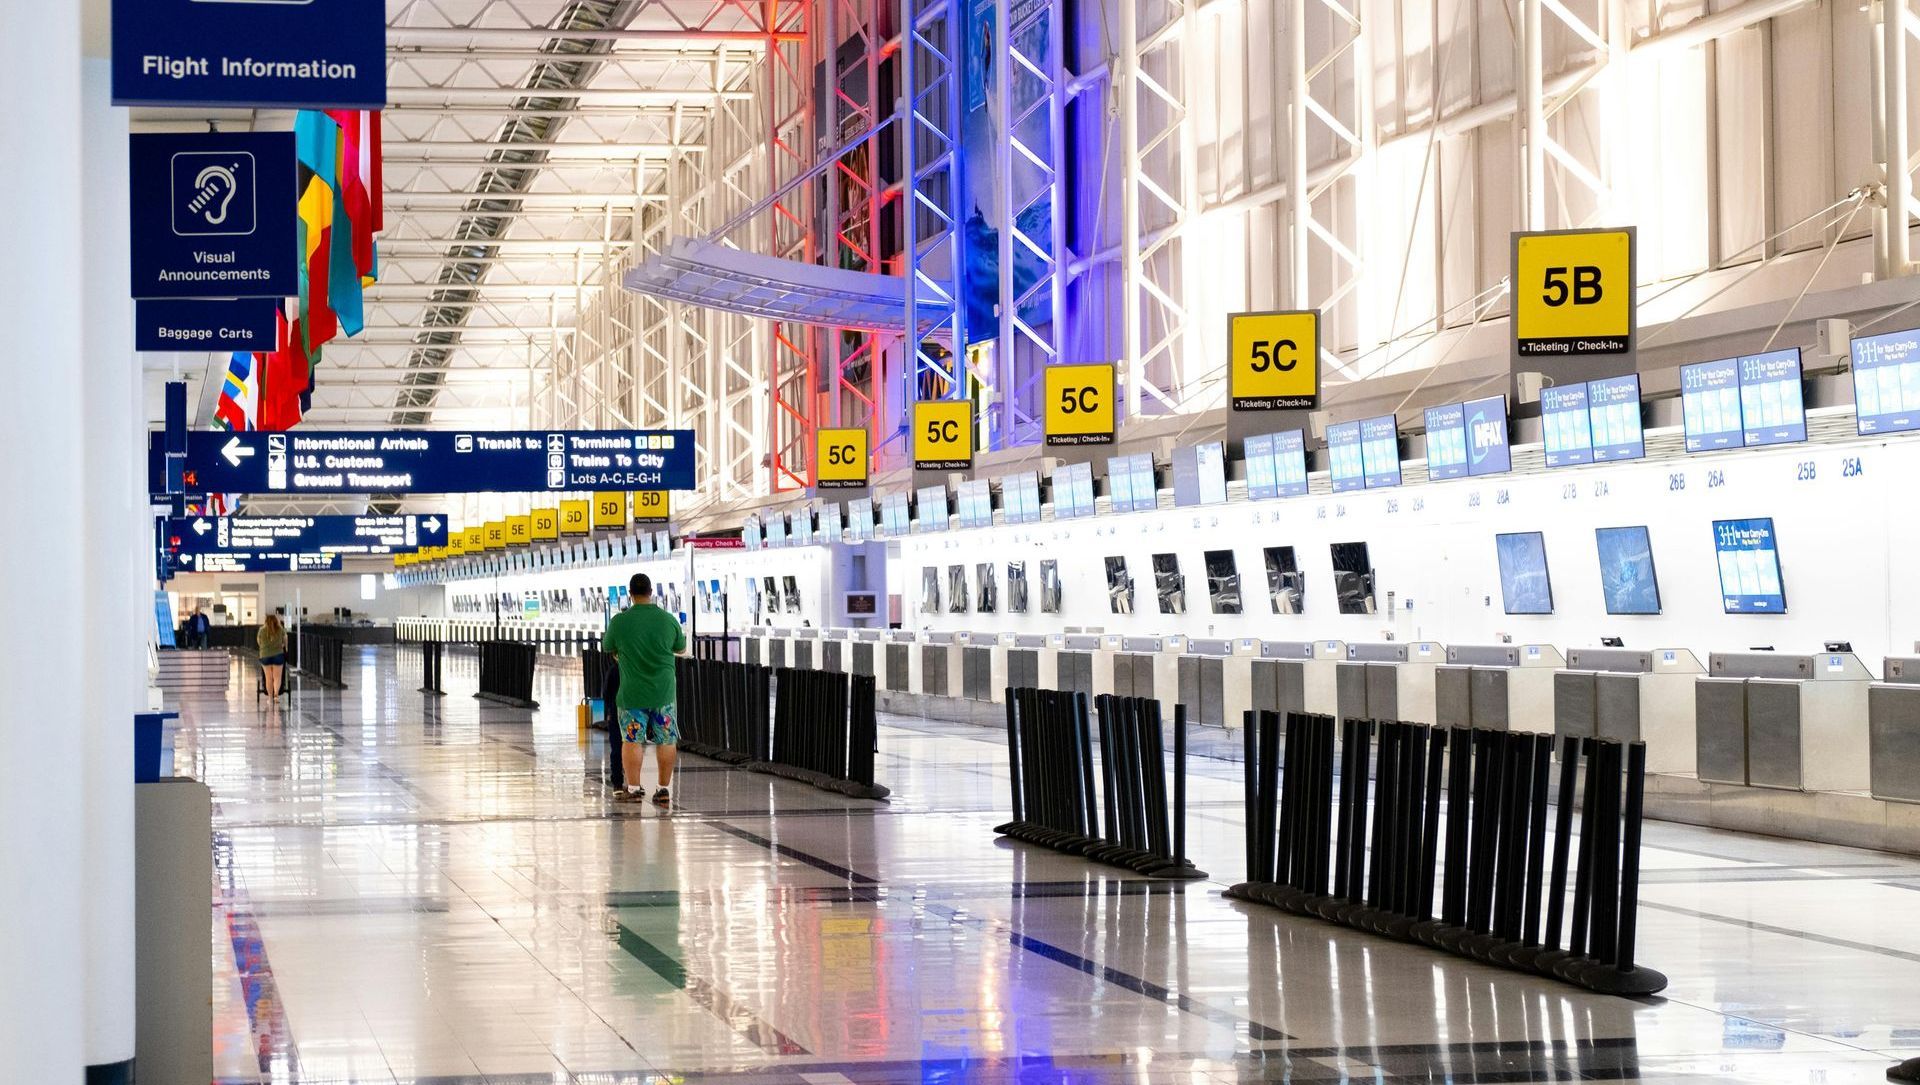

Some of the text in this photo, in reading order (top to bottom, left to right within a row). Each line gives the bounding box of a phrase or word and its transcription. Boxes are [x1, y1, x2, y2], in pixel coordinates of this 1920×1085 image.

[142, 55, 356, 80] Flight Information
[193, 250, 235, 264] Visual
[159, 267, 270, 281] Announcements
[1542, 266, 1603, 307] 5B
[158, 327, 253, 341] Baggage Carts
[1527, 342, 1569, 353] Ticketing
[1577, 340, 1618, 351] Check-In
[1857, 341, 1878, 364] 3-1-1
[1250, 339, 1297, 372] 5C
[1743, 359, 1761, 380] 3-1-1
[1685, 367, 1702, 388] 3-1-1
[1061, 386, 1098, 414] 5C
[1544, 390, 1559, 410] 3-1-1
[1591, 383, 1608, 403] 3-1-1
[1240, 400, 1271, 409] Ticketing
[1276, 398, 1308, 408] Check-In
[927, 419, 959, 444] 5C
[294, 437, 429, 450] International Arrivals
[477, 437, 542, 450] Transit to:
[570, 436, 631, 449] Terminals
[1052, 436, 1077, 444] Ticketing
[1082, 434, 1107, 443] Check-In
[294, 455, 384, 468] U.S. Customs
[570, 454, 664, 468] Trains To City
[829, 444, 856, 465] 5C
[919, 462, 941, 470] Ticketing
[944, 460, 966, 469] Check-In
[1797, 457, 1863, 481] 25B 25A
[294, 473, 411, 488] Ground Transport
[571, 474, 596, 484] Lots
[1669, 470, 1725, 491] 26B 26A
[1562, 480, 1609, 499] 27B 27A
[642, 492, 660, 507] 5D
[600, 502, 618, 516] 5D
[537, 518, 551, 530] 5D
[567, 511, 582, 524] 5D
[489, 529, 501, 541] 5E
[511, 524, 524, 535] 5E
[1718, 525, 1738, 546] 3-1-1
[451, 539, 462, 549] 5E
[469, 534, 481, 545] 5E
